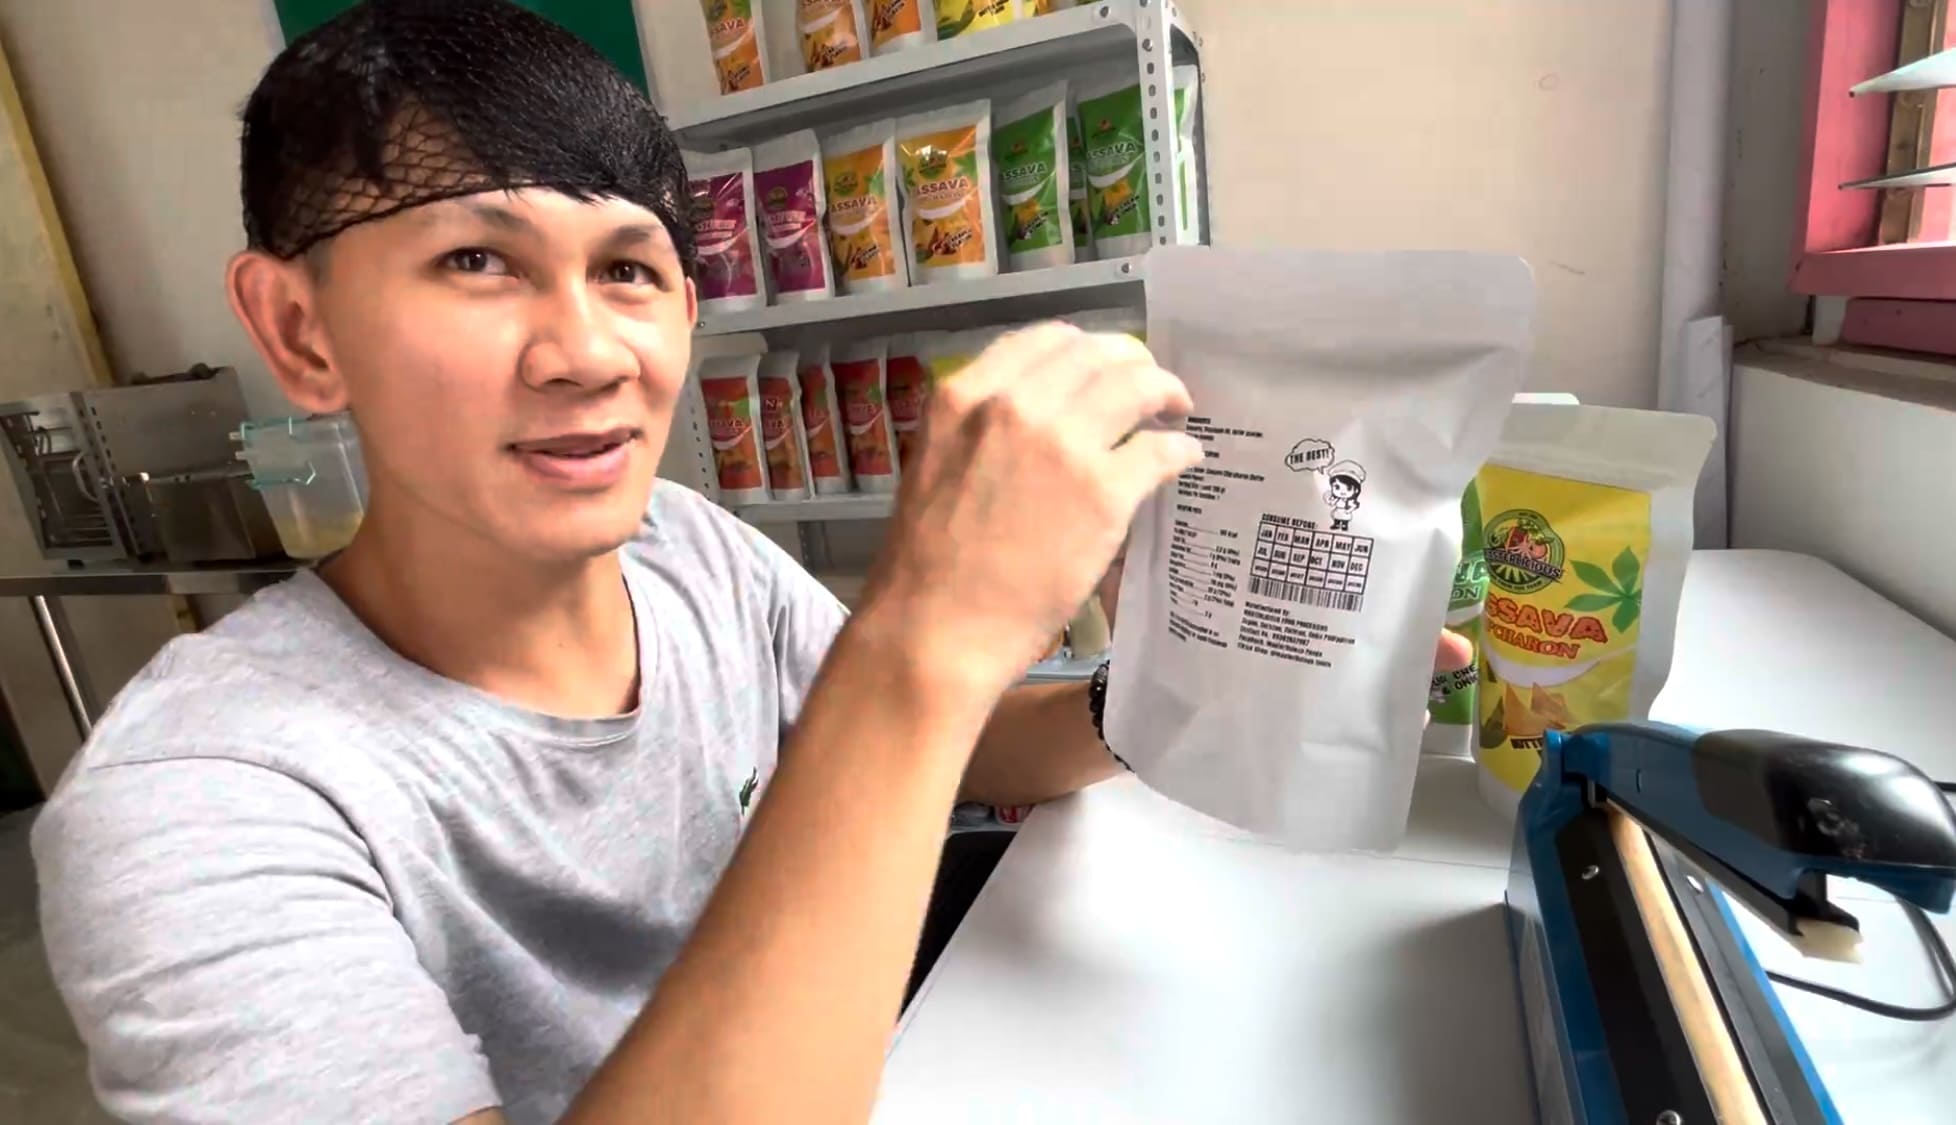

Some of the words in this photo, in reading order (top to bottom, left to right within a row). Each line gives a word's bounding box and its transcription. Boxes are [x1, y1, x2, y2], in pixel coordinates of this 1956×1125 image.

[1290, 452, 1303, 464] THE
[1306, 448, 1329, 461] BEST!
[1262, 513, 1290, 525] CONSUME
[1261, 529, 1272, 538] JAN
[1278, 532, 1289, 541] FEB
[1294, 535, 1310, 545] MAR
[1315, 538, 1330, 548] APR
[1335, 541, 1351, 551] MAY
[1354, 544, 1369, 553] JUN
[1257, 547, 1268, 556] JUL
[1274, 550, 1286, 559] AUG
[1293, 553, 1305, 562] SEP
[1310, 556, 1323, 566] OCT
[1331, 560, 1345, 569] NOV
[1350, 562, 1363, 571] DEC
